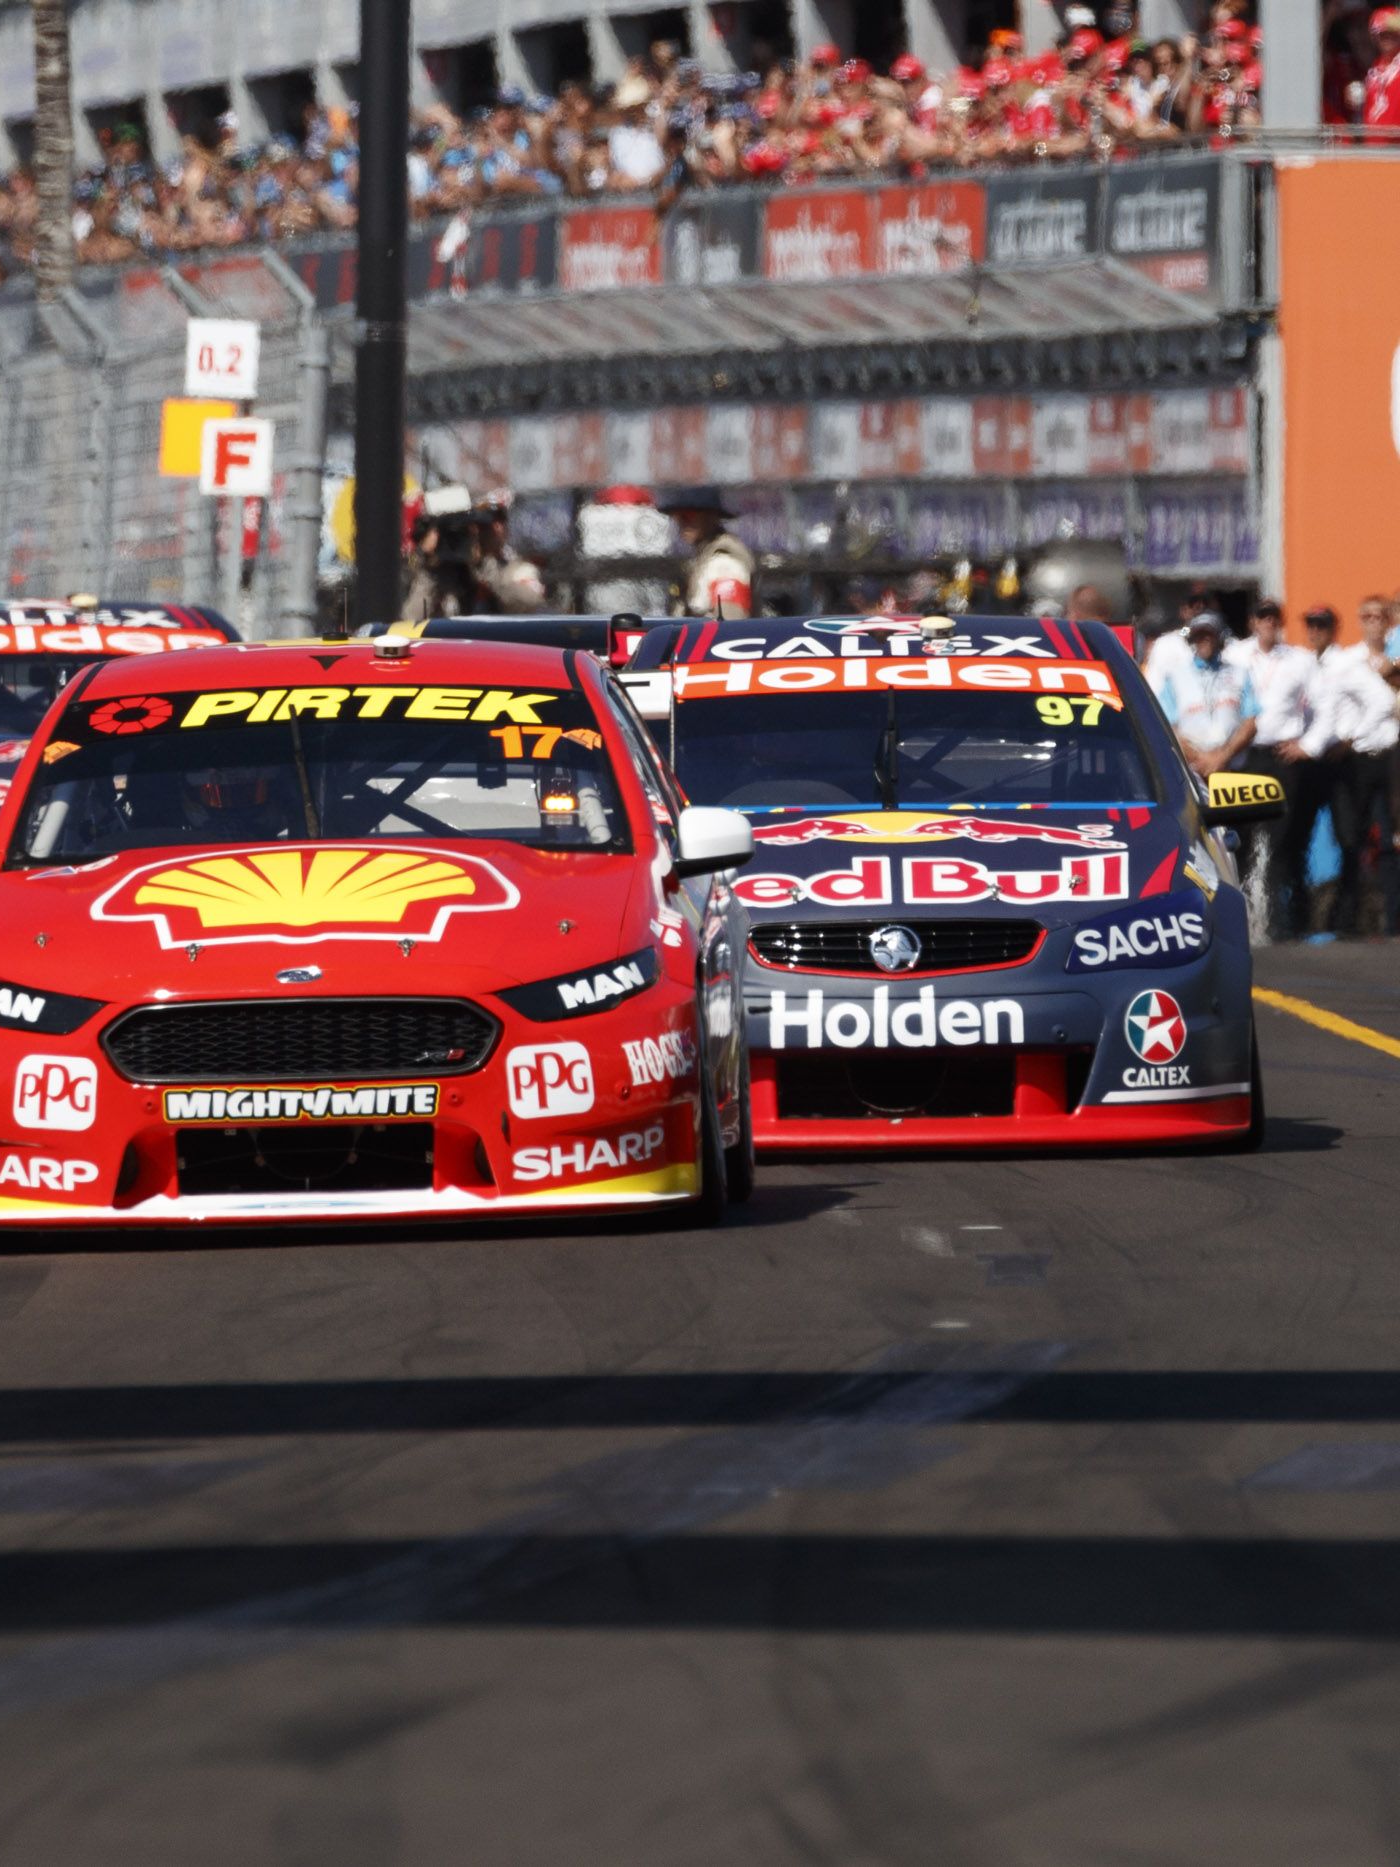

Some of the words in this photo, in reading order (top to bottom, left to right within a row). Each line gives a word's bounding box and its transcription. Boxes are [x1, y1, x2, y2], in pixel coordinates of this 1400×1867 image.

[198, 345, 242, 376] 0.2
[214, 432, 257, 487] F
[711, 634, 1059, 659] CALTEX
[674, 657, 1112, 696] Holden
[180, 687, 559, 728] PIRTEK
[1034, 695, 1104, 726] 97
[489, 725, 565, 759] 17
[1213, 782, 1281, 806] IVECO
[731, 856, 893, 907] ed
[902, 852, 1129, 904] Bull
[1073, 912, 1204, 967] SACHS
[557, 962, 646, 1010] MAN
[768, 984, 1025, 1049] Holden
[511, 1051, 590, 1110] PPG
[622, 1030, 687, 1087] HOGS
[1122, 1064, 1192, 1088] CALTEX
[17, 1062, 92, 1121] PPG
[511, 1125, 665, 1182] SHARP
